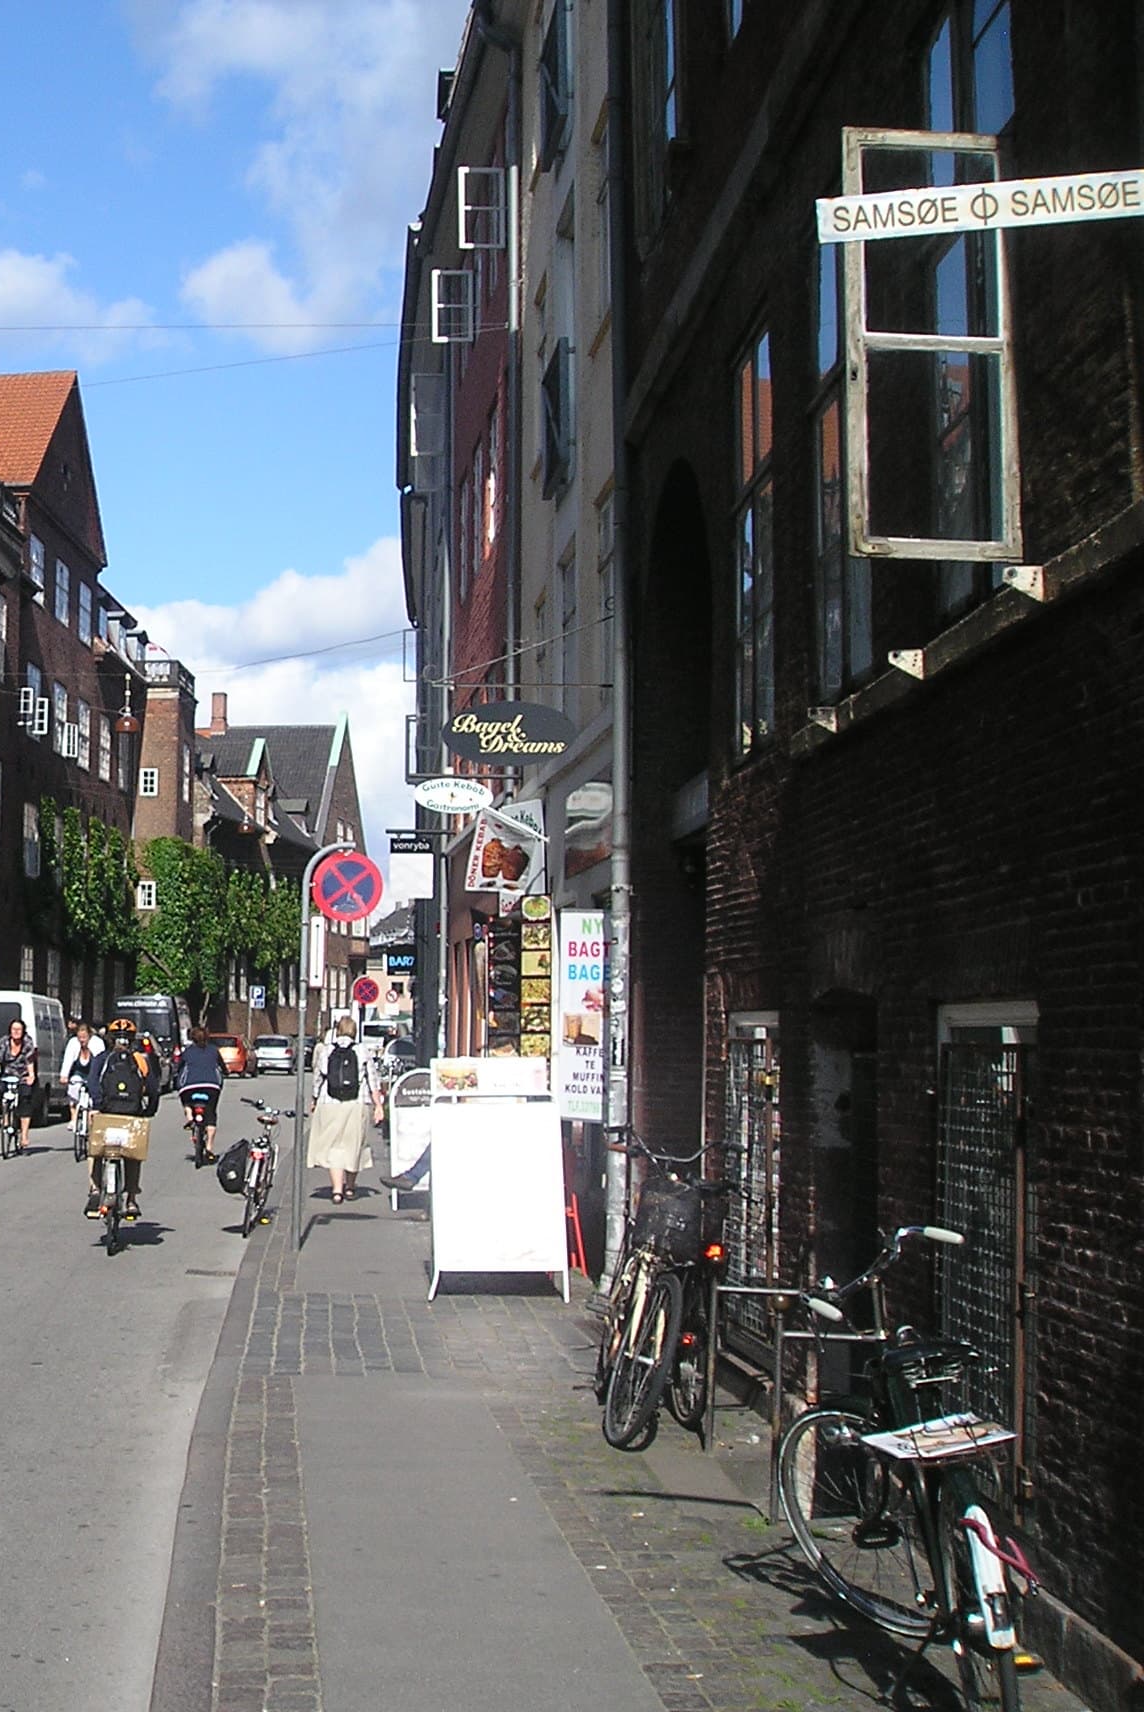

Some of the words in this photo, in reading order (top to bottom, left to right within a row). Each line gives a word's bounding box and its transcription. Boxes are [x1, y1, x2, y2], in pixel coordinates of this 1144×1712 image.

[832, 196, 959, 232] SAMSØE
[1011, 179, 1143, 217] SAMSØE
[452, 713, 524, 739] Bagel
[479, 734, 568, 753] Dreams
[567, 941, 611, 958] BAGT
[253, 987, 262, 999] P
[585, 1060, 596, 1070] TE
[564, 1084, 588, 1095] KOLD
